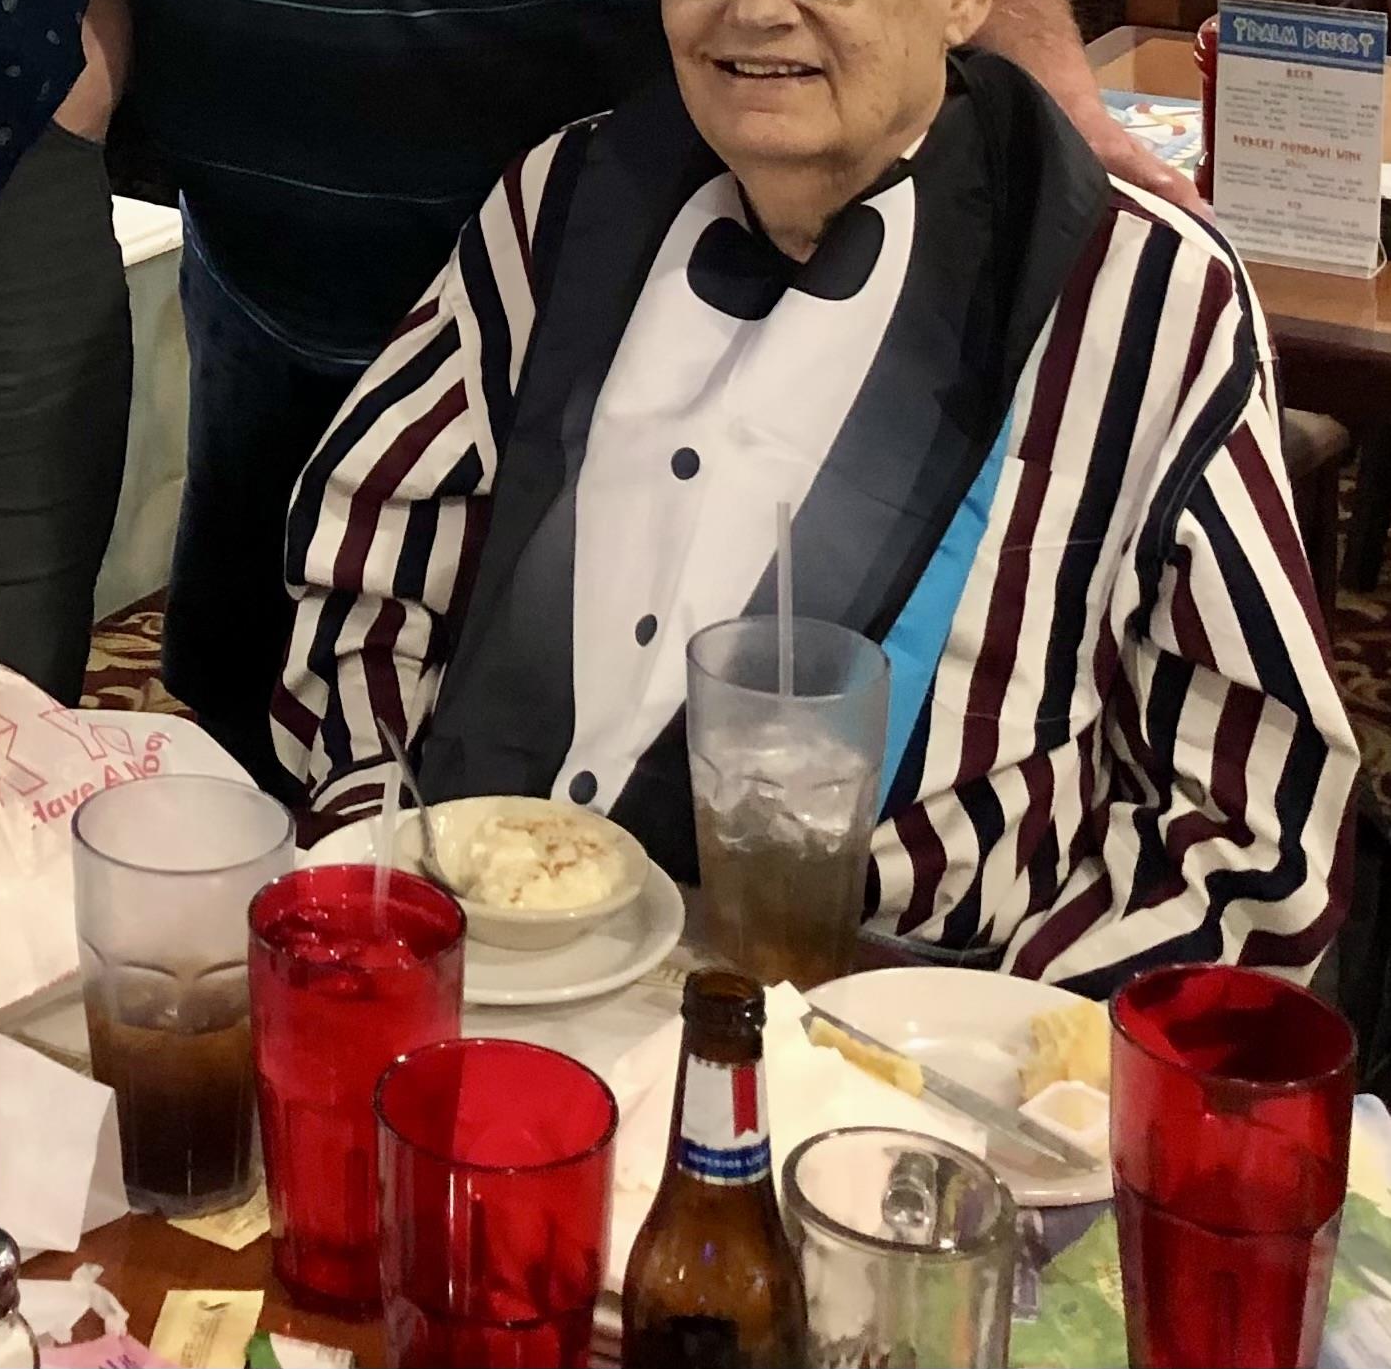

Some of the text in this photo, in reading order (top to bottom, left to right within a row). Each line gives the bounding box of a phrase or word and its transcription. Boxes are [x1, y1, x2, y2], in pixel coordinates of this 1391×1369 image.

[1246, 20, 1358, 54] PALM DINER
[1233, 134, 1362, 163] ROBERT MONDAVI WINE
